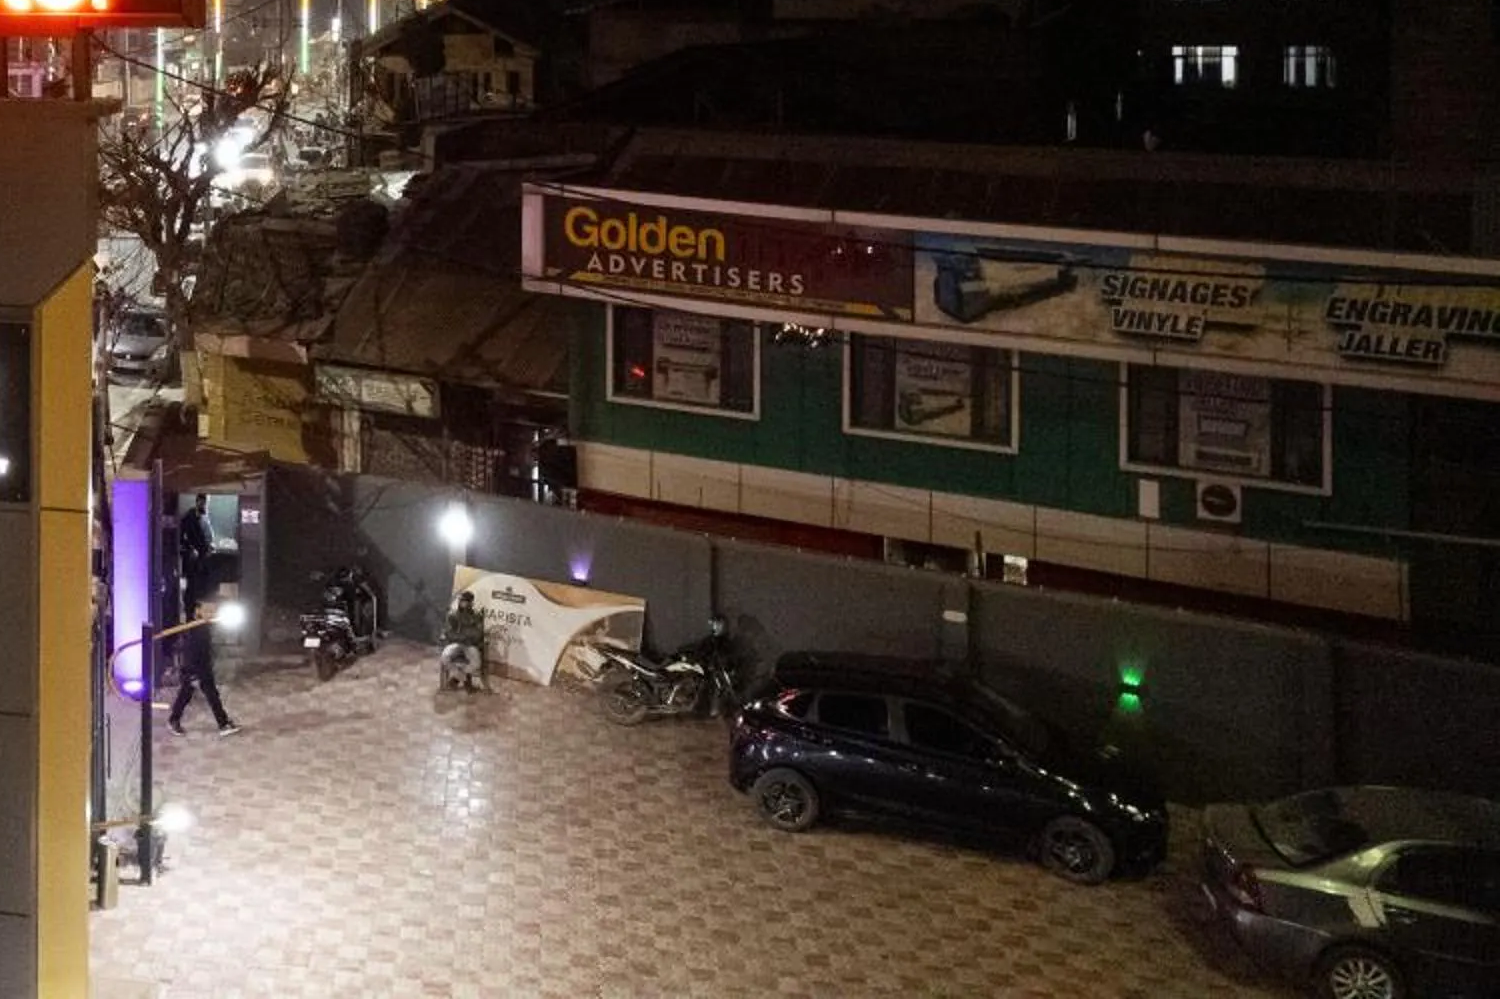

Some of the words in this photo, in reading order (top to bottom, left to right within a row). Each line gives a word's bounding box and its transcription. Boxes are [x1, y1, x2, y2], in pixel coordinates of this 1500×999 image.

[564, 206, 726, 261] Golden
[587, 252, 806, 295] ADVERTISERS
[1101, 274, 1250, 309] SIGNAGES
[1112, 309, 1203, 336] VINYLE
[1338, 333, 1444, 361] JALLER
